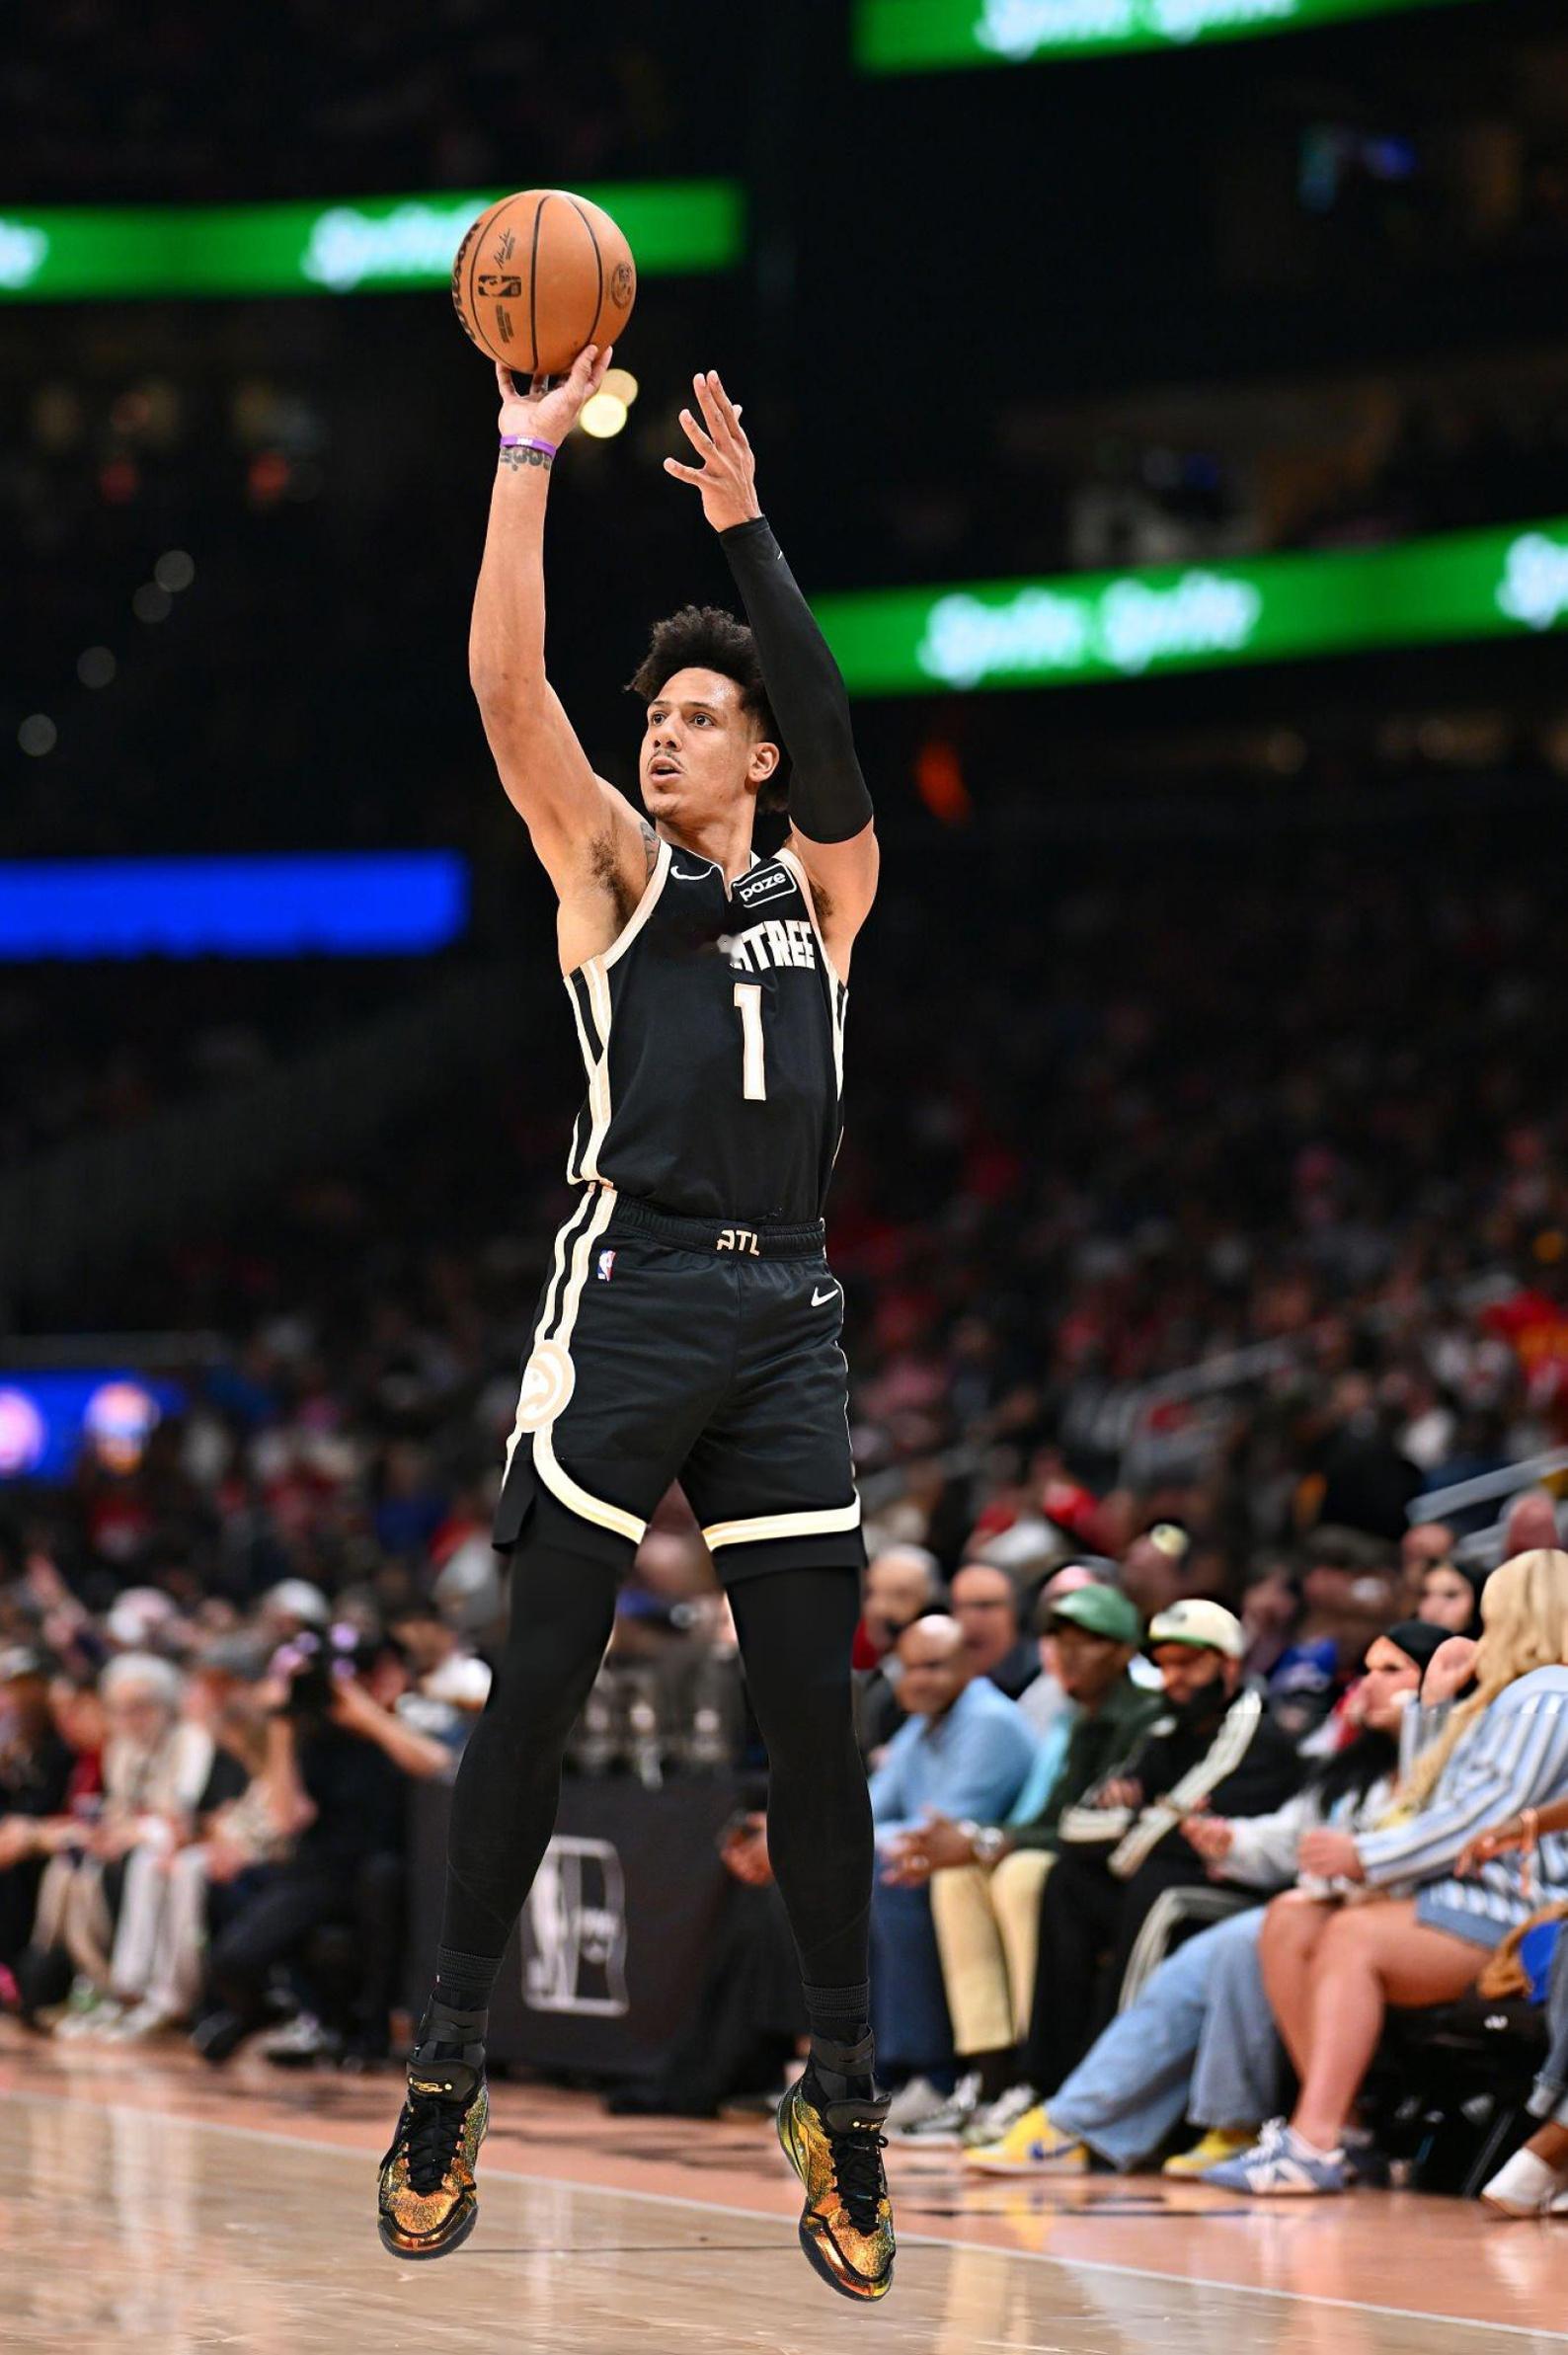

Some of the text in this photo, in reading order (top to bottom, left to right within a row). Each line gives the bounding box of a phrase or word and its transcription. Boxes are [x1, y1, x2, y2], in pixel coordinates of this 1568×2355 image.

[740, 873, 786, 902] paze
[734, 982, 766, 1101] 1
[717, 1229, 760, 1256] ATL
